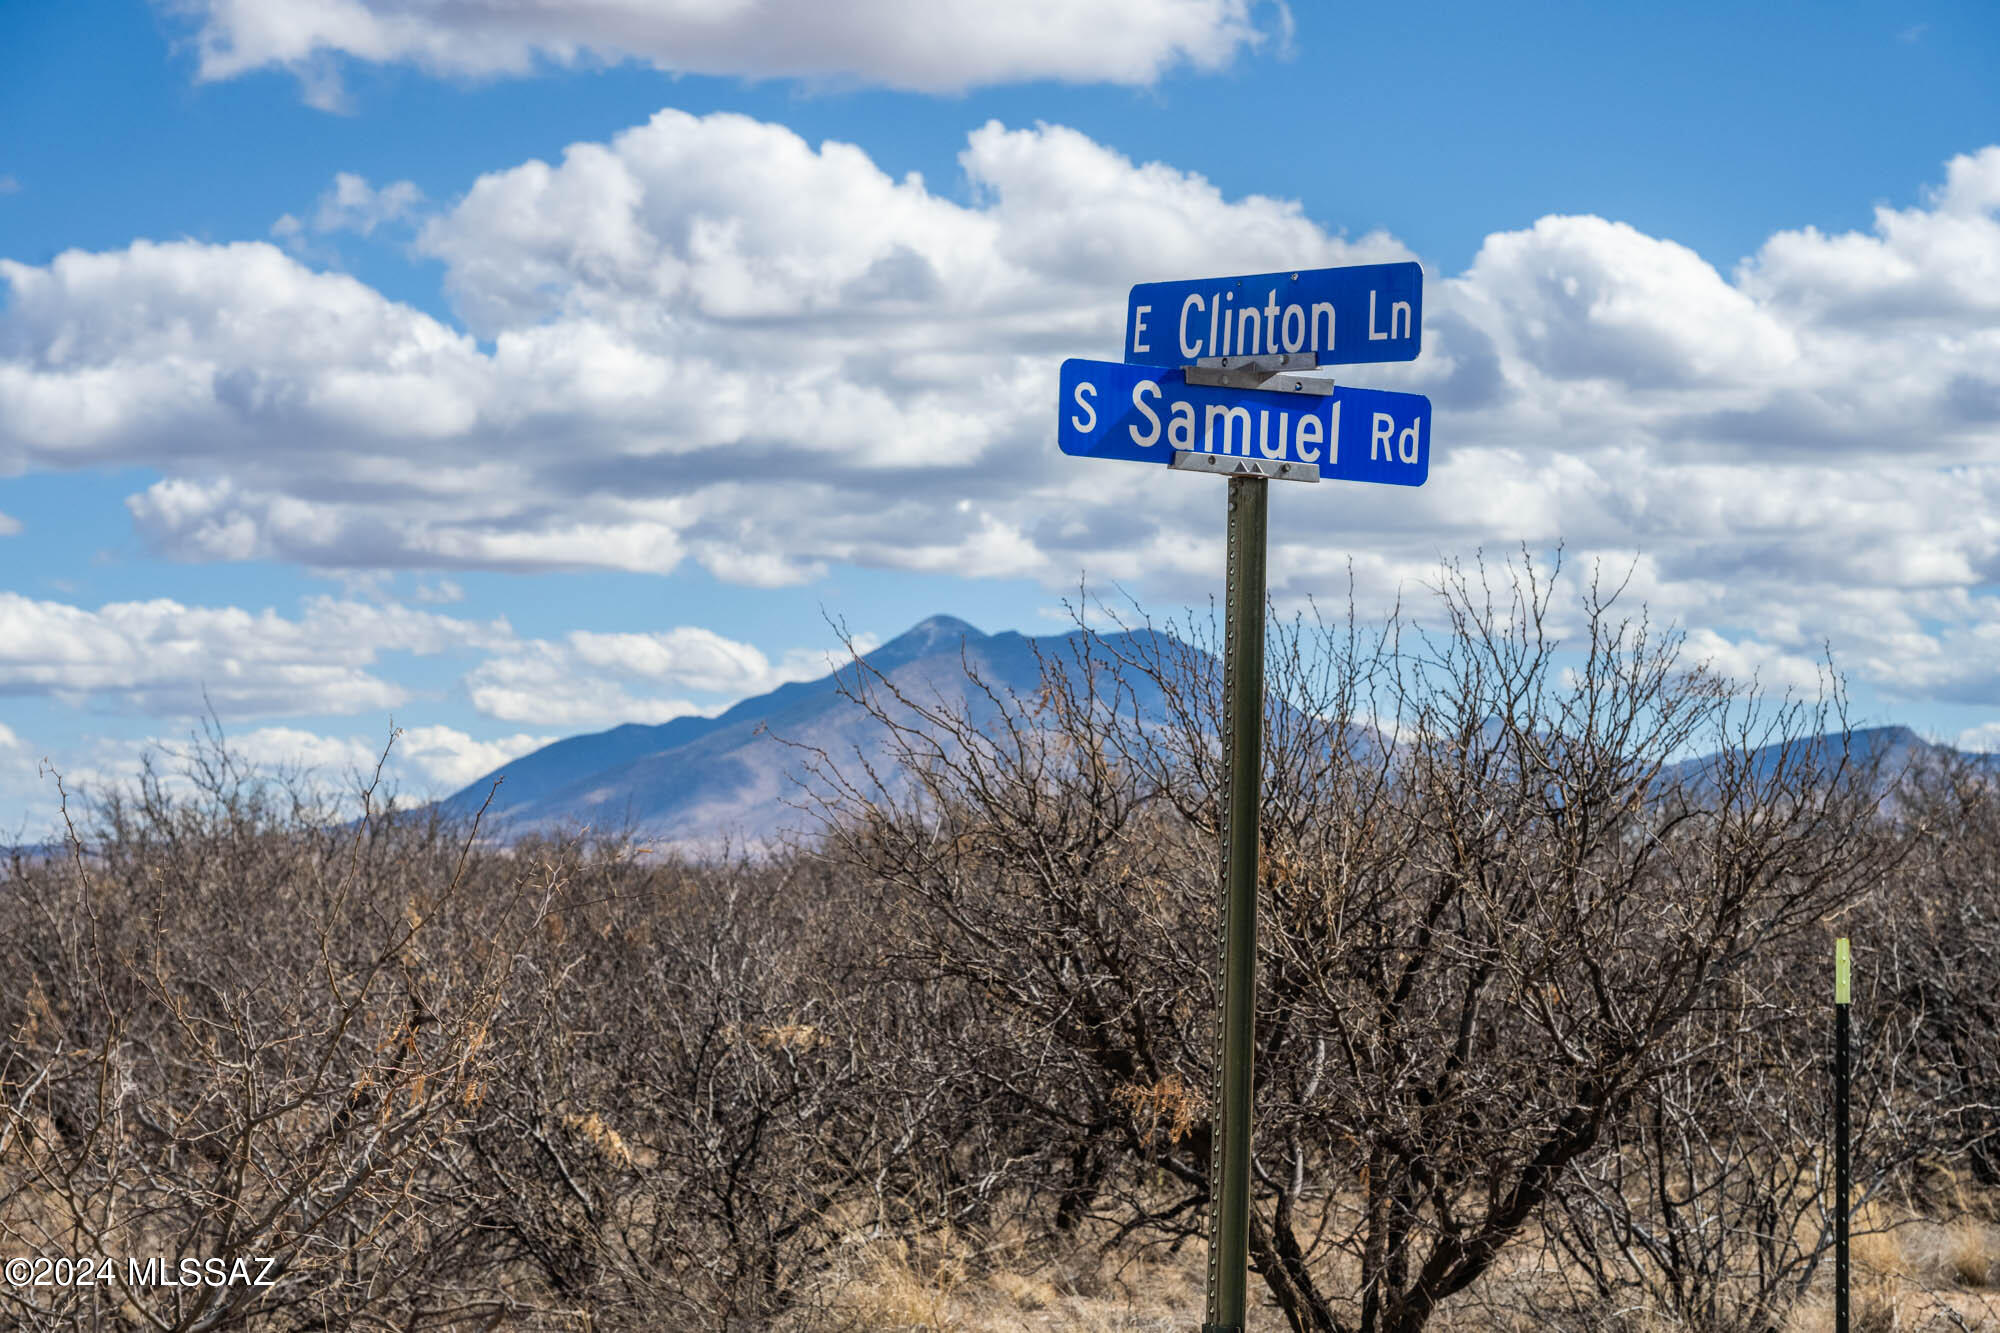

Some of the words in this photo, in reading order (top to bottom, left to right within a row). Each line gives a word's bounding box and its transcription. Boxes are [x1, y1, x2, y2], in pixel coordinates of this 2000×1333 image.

[1132, 304, 1153, 354] E
[1178, 288, 1337, 360] Clinton
[1368, 289, 1412, 342] Ln
[1071, 381, 1098, 434] S
[1128, 379, 1342, 465] Samuel
[1370, 411, 1421, 465] Rd
